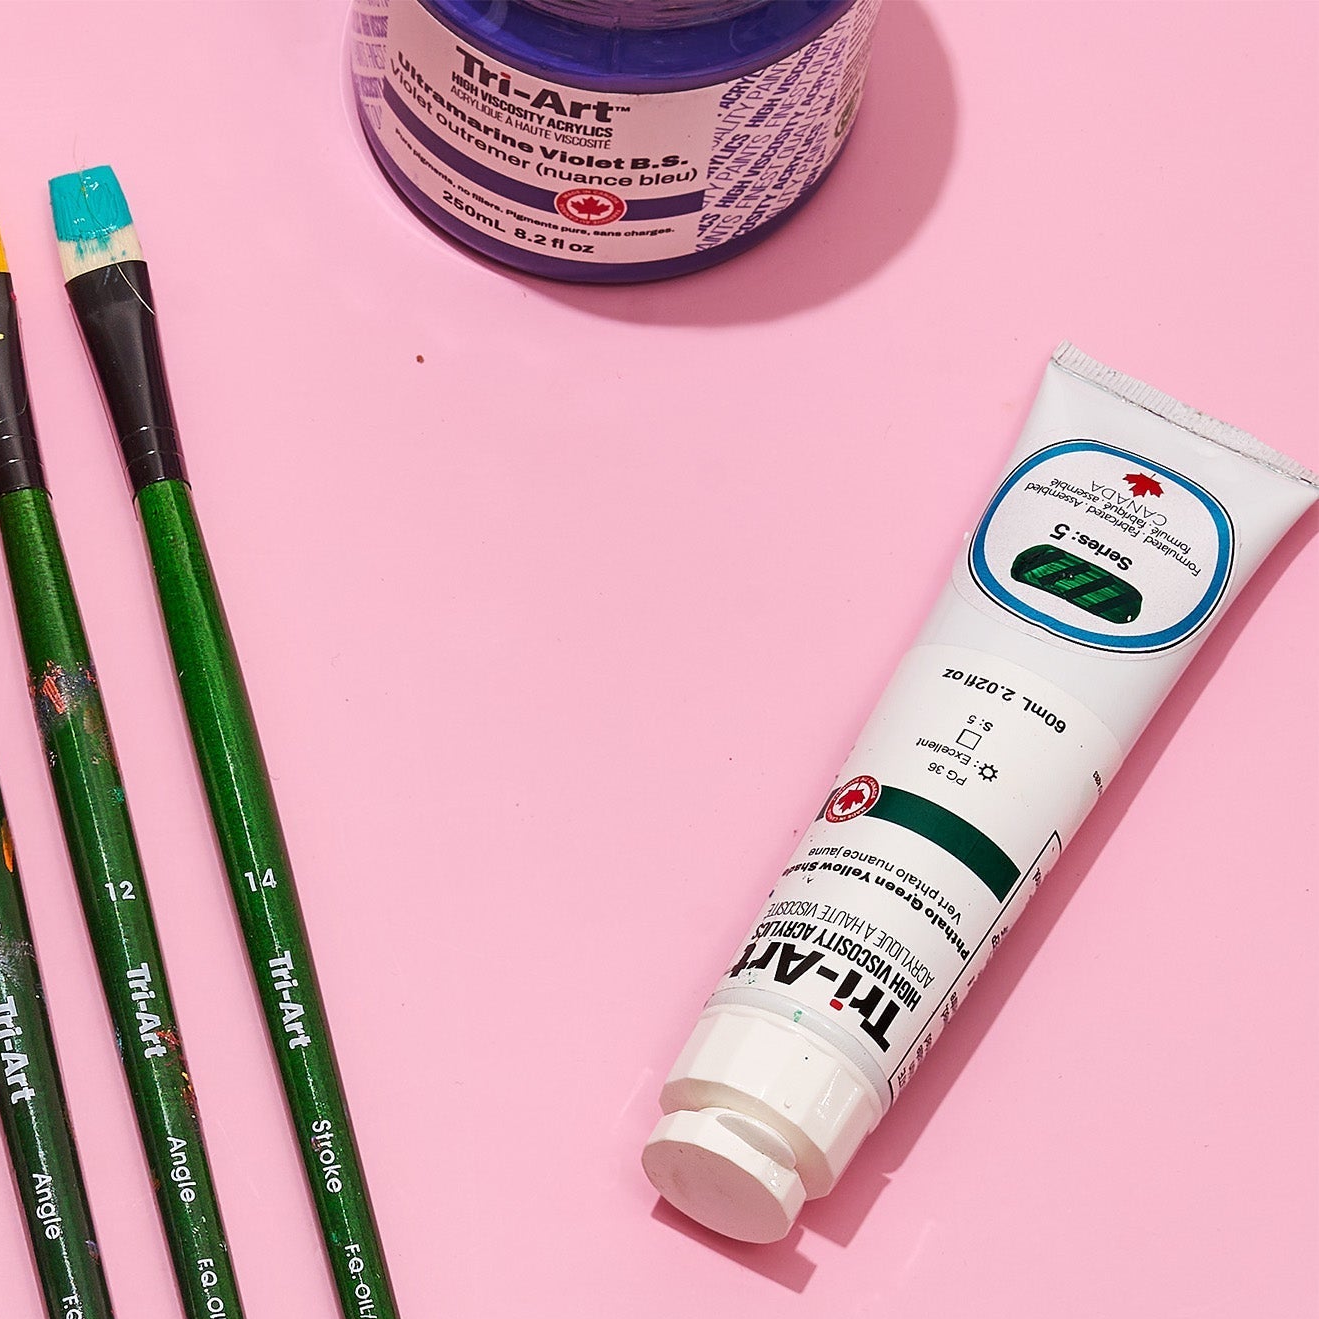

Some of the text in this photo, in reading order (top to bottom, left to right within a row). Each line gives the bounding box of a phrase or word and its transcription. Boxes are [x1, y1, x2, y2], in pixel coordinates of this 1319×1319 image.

[391, 57, 698, 187] Violet outremer (nuance bleu)
[397, 51, 689, 170] Ultramarine Violet B.S.
[450, 84, 611, 150] ACRYLIQUE HAUTE VISCOSITÉ
[452, 71, 613, 139] HIGH VISCOSITY ACRYLICS
[442, 190, 595, 254] 250mL 8.2 oz
[506, 208, 559, 231] Pigments
[1025, 482, 1202, 578] Formulated Fabricated Assembled
[1050, 477, 1192, 555] formulé fabriqué assemblé
[1091, 479, 1168, 527] CANADA
[1071, 530, 1133, 571] Series:
[1022, 695, 1068, 735] 60mL
[916, 737, 972, 767] Excellent
[104, 880, 136, 902] 12
[244, 868, 277, 892] 14
[818, 860, 970, 961] Phthalo Green Yellow
[842, 847, 962, 924] Vert phtalo nuance
[752, 921, 823, 943] ACRYLICS
[816, 929, 890, 987] VISCOSITY
[818, 910, 934, 989] ACRYLIQUE HAUTE
[127, 962, 168, 1060] Tri-Art
[269, 950, 311, 1050] Tri-Art
[890, 974, 921, 1012] HIGH
[166, 1136, 197, 1203] Angle
[311, 1119, 343, 1194] Stroke
[32, 1173, 62, 1240] Angle
[197, 1258, 218, 1293] F.Q.
[345, 1243, 365, 1280] F.Q.
